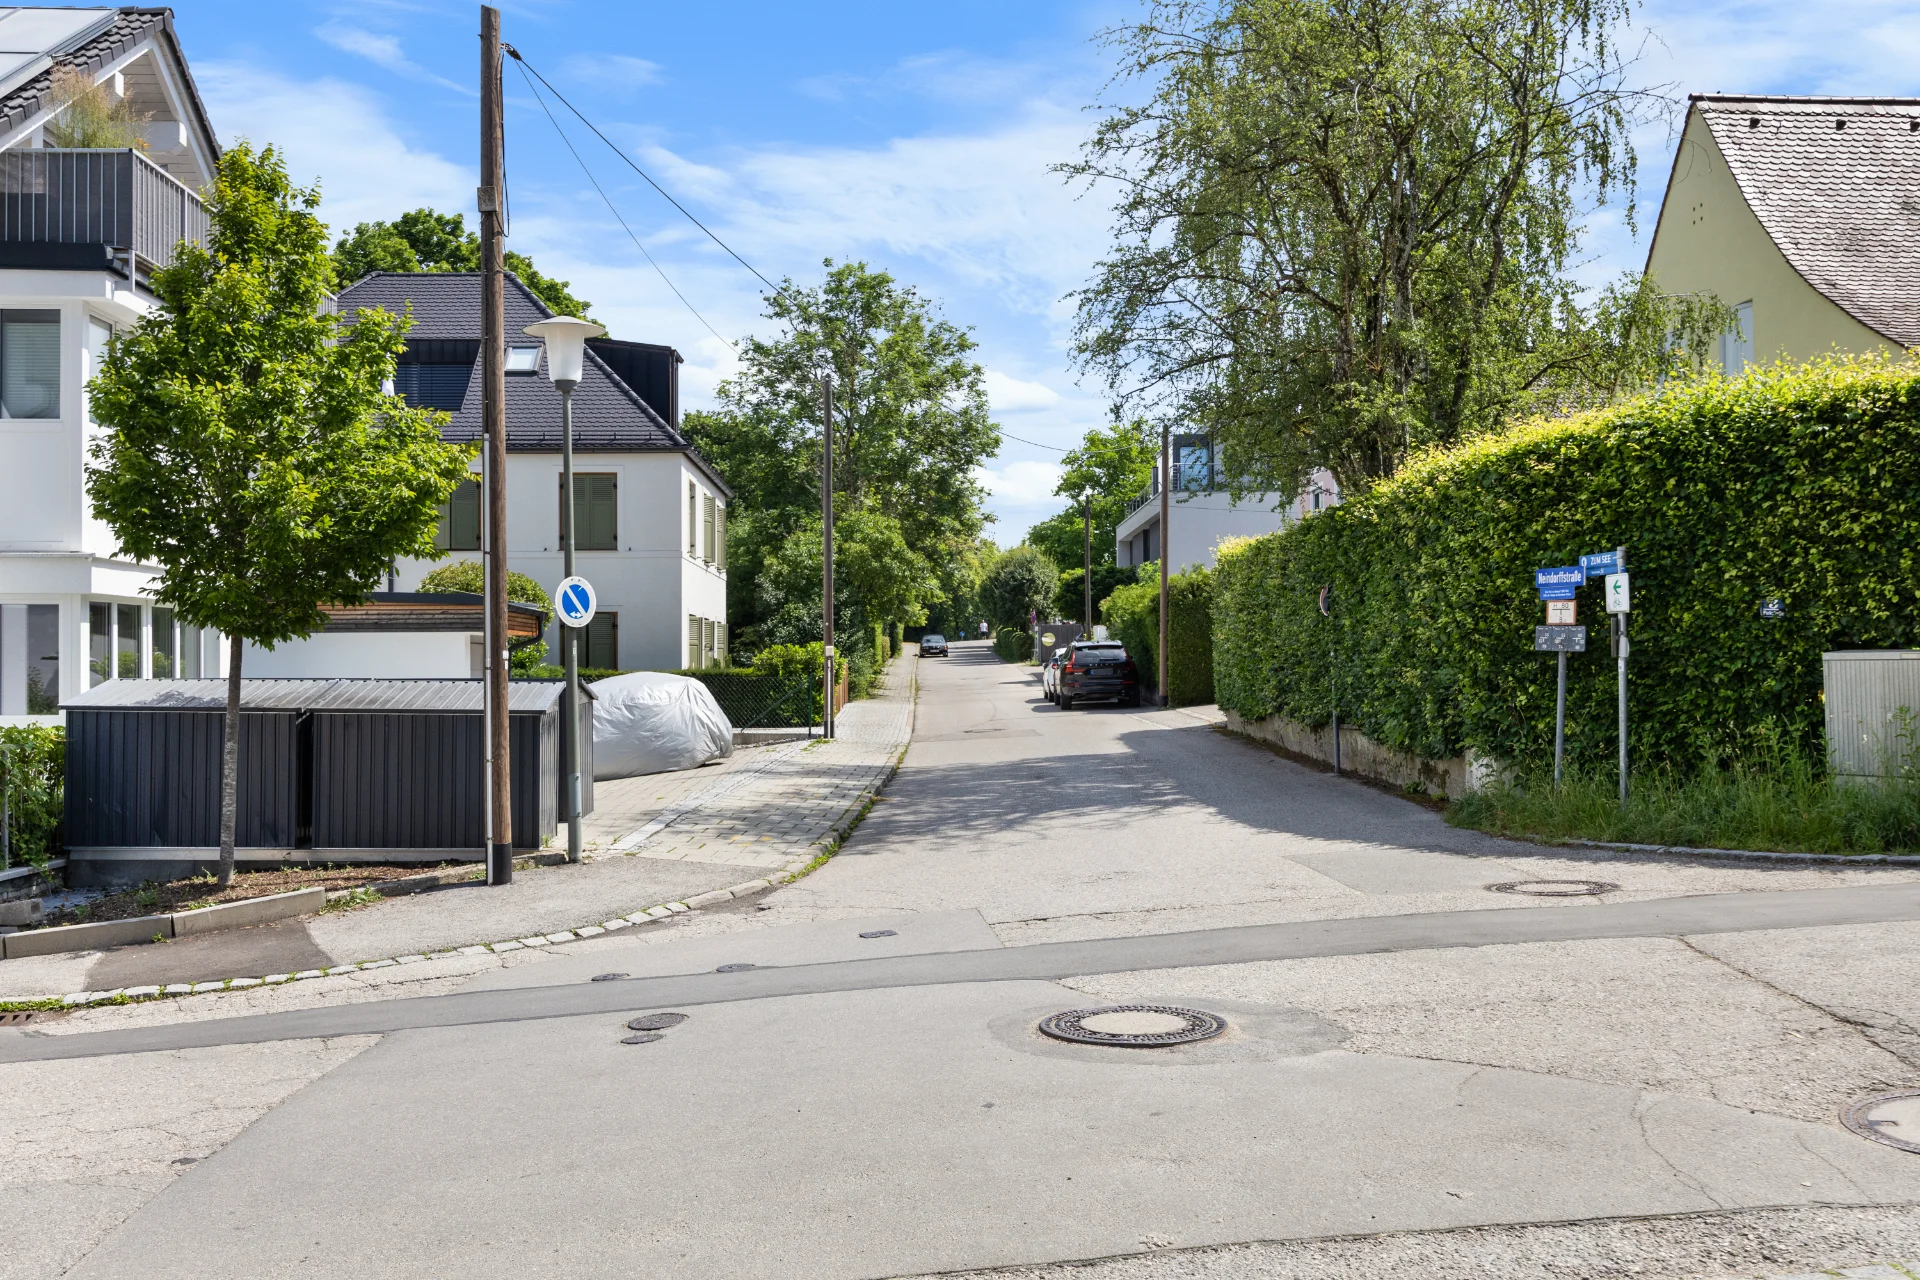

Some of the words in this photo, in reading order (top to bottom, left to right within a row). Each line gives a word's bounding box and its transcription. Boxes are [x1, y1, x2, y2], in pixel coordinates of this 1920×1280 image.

[1590, 556, 1601, 565] ZUM
[1602, 554, 1611, 564] SEE
[1538, 570, 1582, 584] Neindorffstraße
